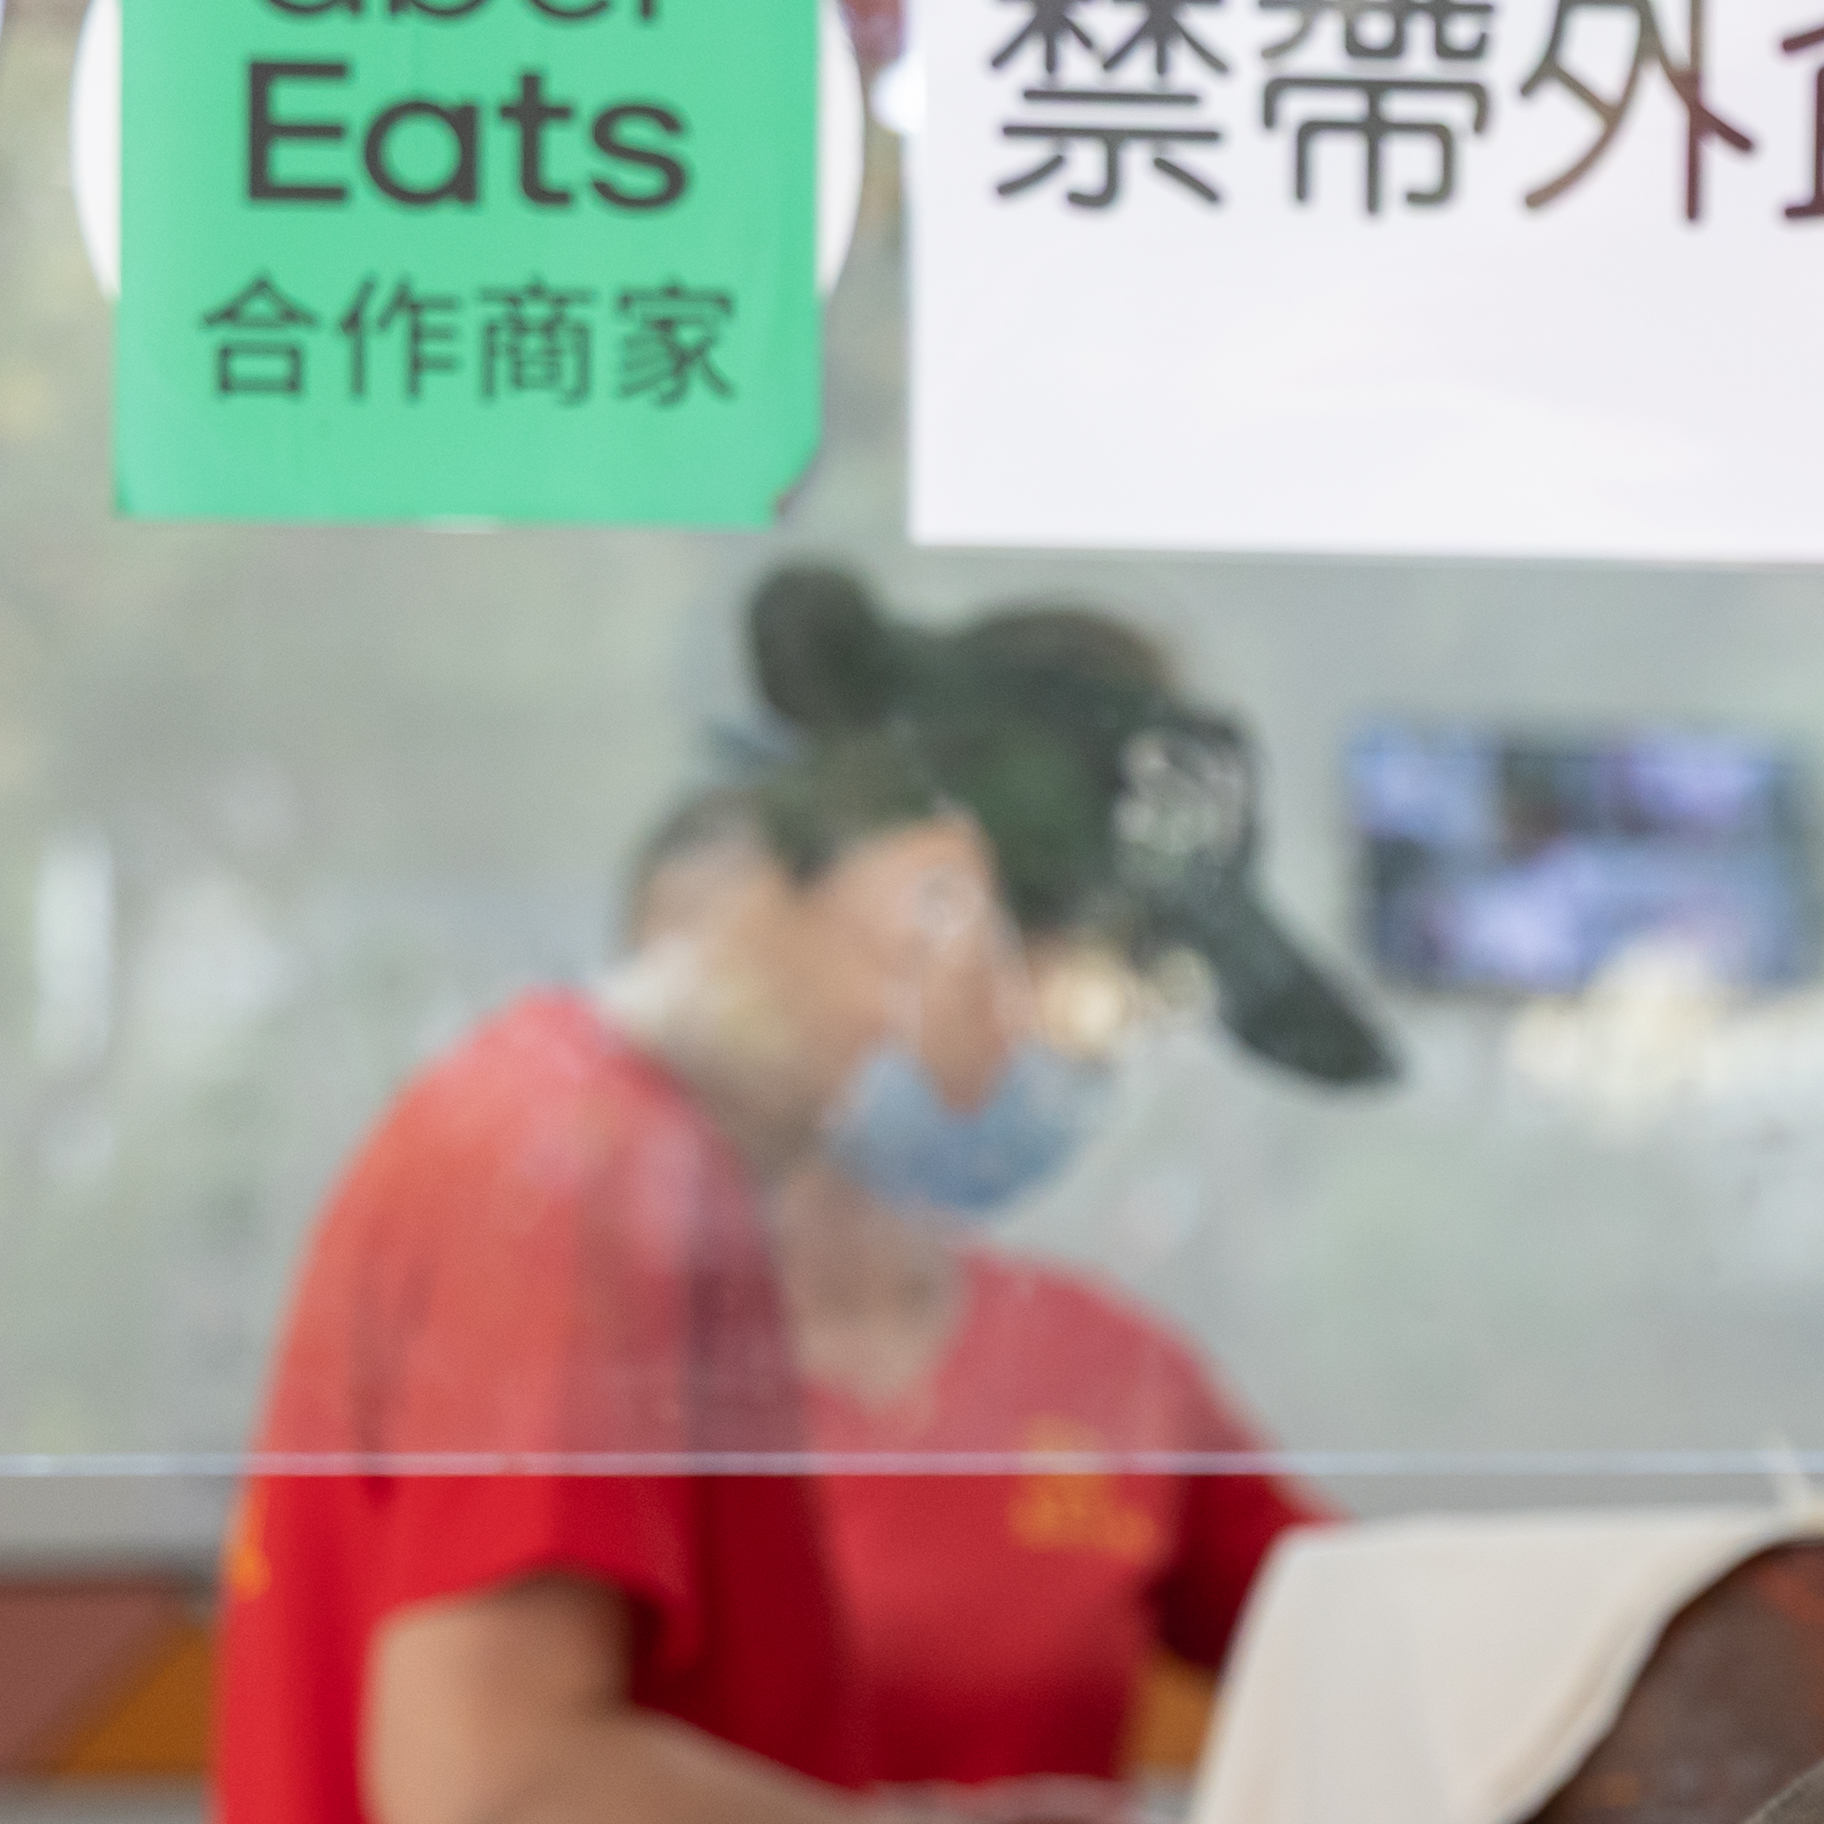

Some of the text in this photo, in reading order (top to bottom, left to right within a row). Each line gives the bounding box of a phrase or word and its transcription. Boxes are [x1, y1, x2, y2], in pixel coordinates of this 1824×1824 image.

[248, 60, 690, 210] Eats
[201, 275, 735, 405] 合作商家
